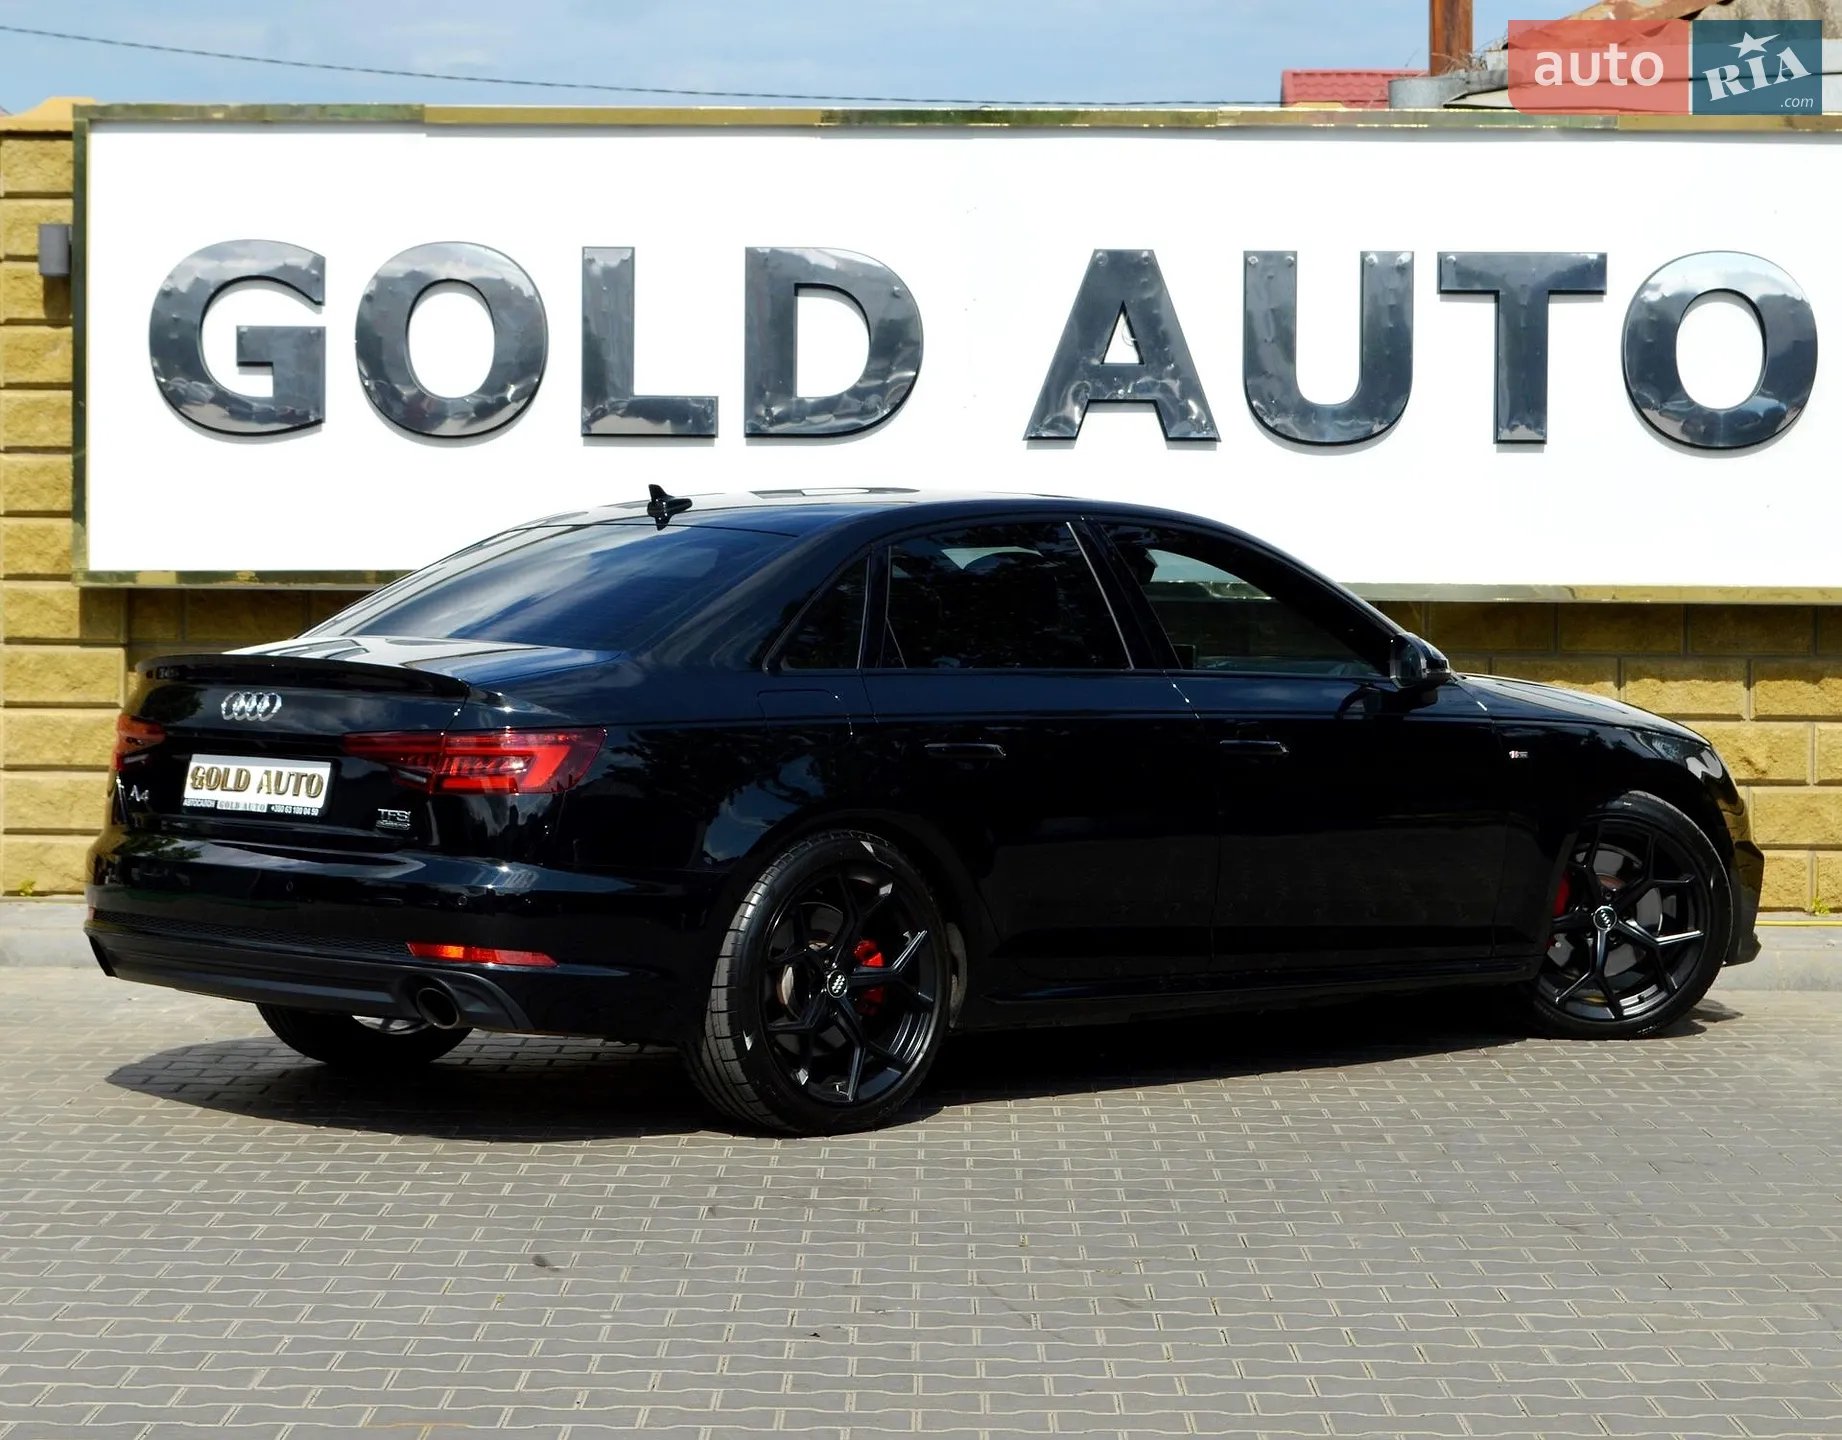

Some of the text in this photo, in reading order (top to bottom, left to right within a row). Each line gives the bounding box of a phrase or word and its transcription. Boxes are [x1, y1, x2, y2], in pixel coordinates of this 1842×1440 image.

[148, 239, 1819, 449] GOLD AUTO
[190, 765, 324, 798] GOLD AUTO
